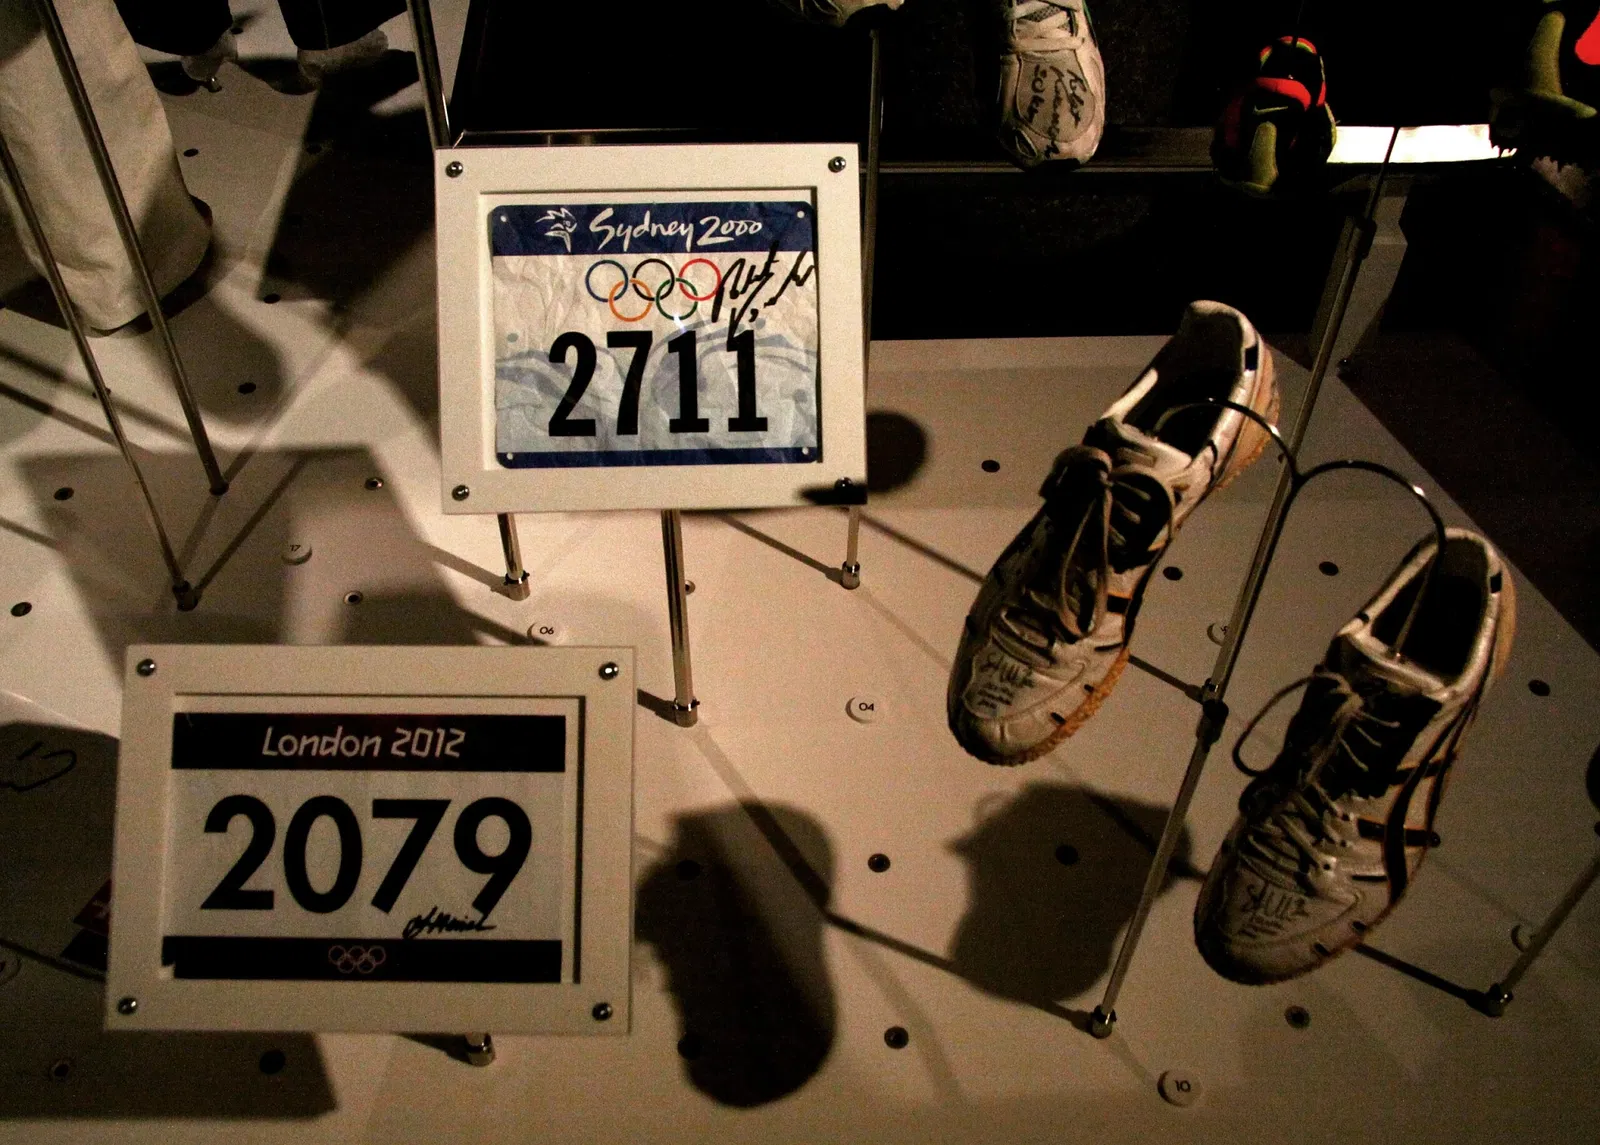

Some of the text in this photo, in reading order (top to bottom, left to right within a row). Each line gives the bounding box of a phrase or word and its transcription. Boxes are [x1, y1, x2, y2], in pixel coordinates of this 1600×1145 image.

[588, 207, 764, 252] Sydney 2000
[549, 330, 768, 437] 2711
[539, 626, 555, 635] 06
[858, 702, 875, 711] 04
[261, 725, 468, 759] London 2012
[201, 794, 532, 914] 2079
[1174, 1080, 1191, 1093] 10
